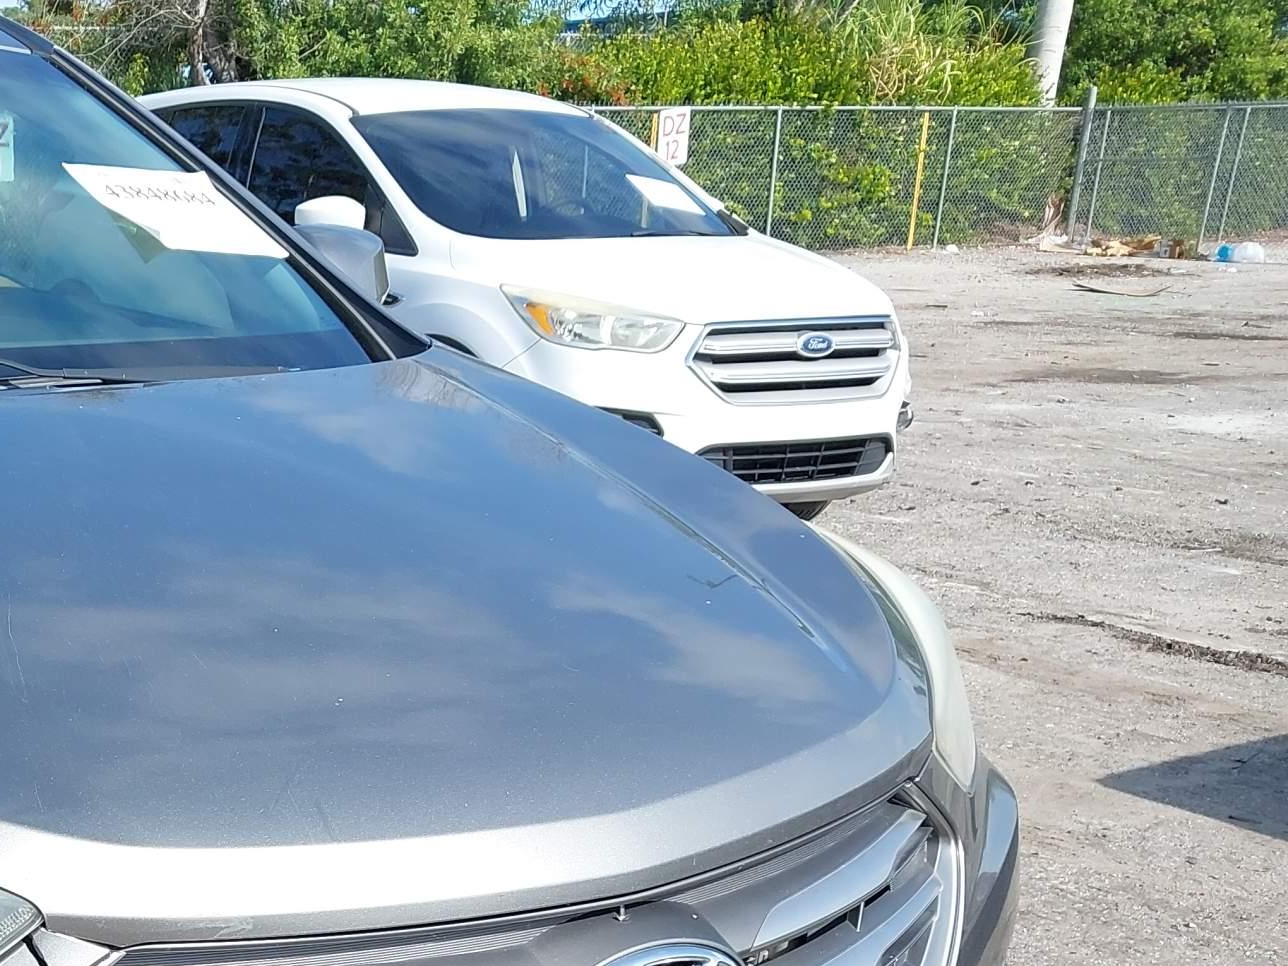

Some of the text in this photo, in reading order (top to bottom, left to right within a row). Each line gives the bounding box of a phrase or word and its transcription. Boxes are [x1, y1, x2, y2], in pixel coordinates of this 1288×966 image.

[662, 113, 686, 136] DZ
[665, 140, 679, 160] 12
[807, 337, 829, 350] Ford
